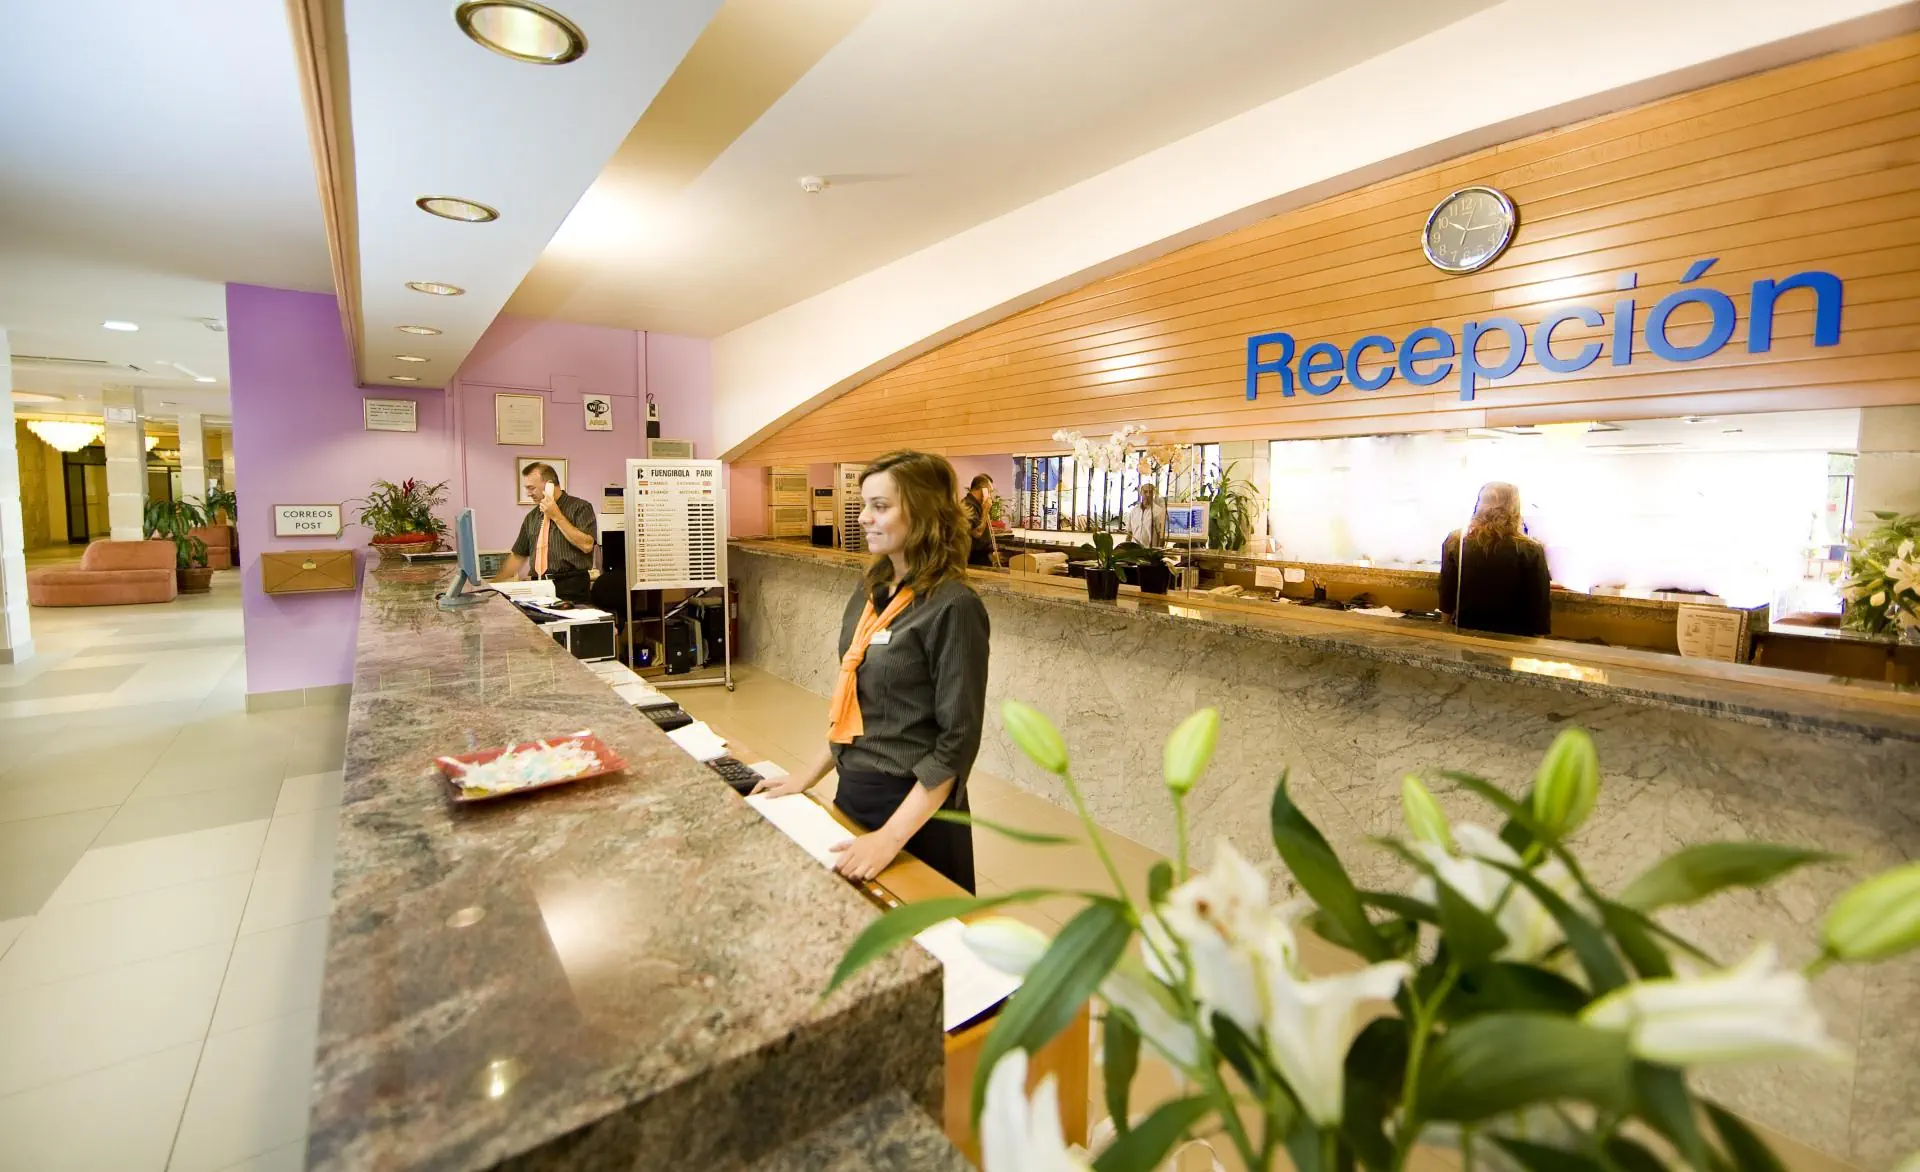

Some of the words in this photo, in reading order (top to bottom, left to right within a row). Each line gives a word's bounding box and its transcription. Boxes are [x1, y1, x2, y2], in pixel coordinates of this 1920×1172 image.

[1450, 204, 1458, 216] 11
[1460, 198, 1472, 211] 12
[1439, 216, 1449, 230] 10
[1433, 232, 1440, 243] 9
[1488, 232, 1495, 245] 4
[1439, 244, 1447, 256] 8
[1450, 250, 1457, 262] 7
[1246, 258, 1843, 402] Recepción
[651, 469, 690, 478] FUENGIROLA
[696, 469, 713, 478] PARK
[283, 510, 333, 518] CORREOS
[295, 522, 322, 530] POST
